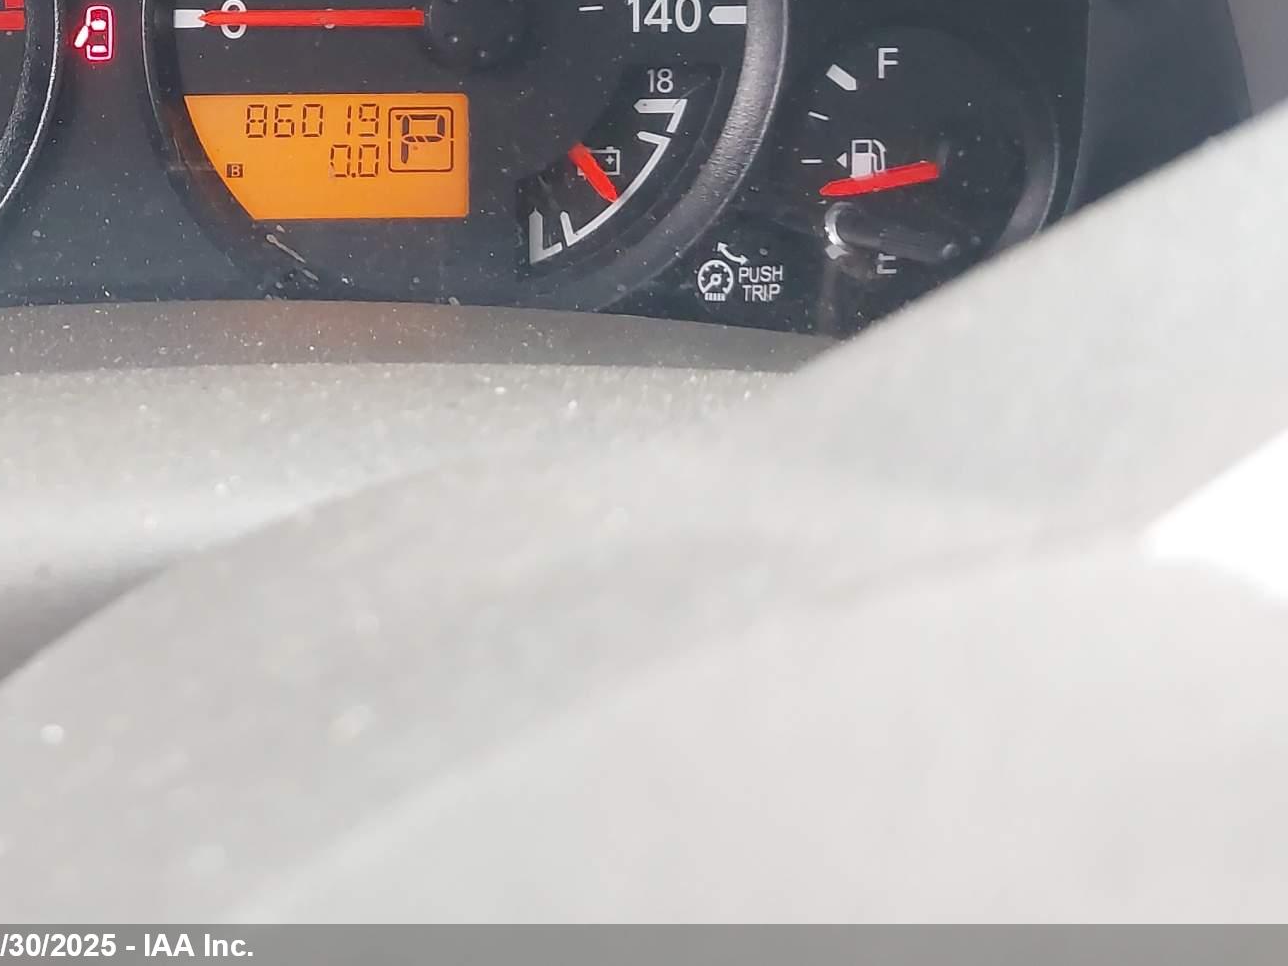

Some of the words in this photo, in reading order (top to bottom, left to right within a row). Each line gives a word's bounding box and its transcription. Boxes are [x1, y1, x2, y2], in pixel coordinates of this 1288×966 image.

[877, 47, 899, 79] F
[648, 68, 674, 94] 18
[245, 103, 381, 139] 86019
[395, 114, 446, 165] P
[330, 144, 381, 178] 0.0
[738, 265, 783, 284] PUSH
[742, 284, 781, 302] TRIP
